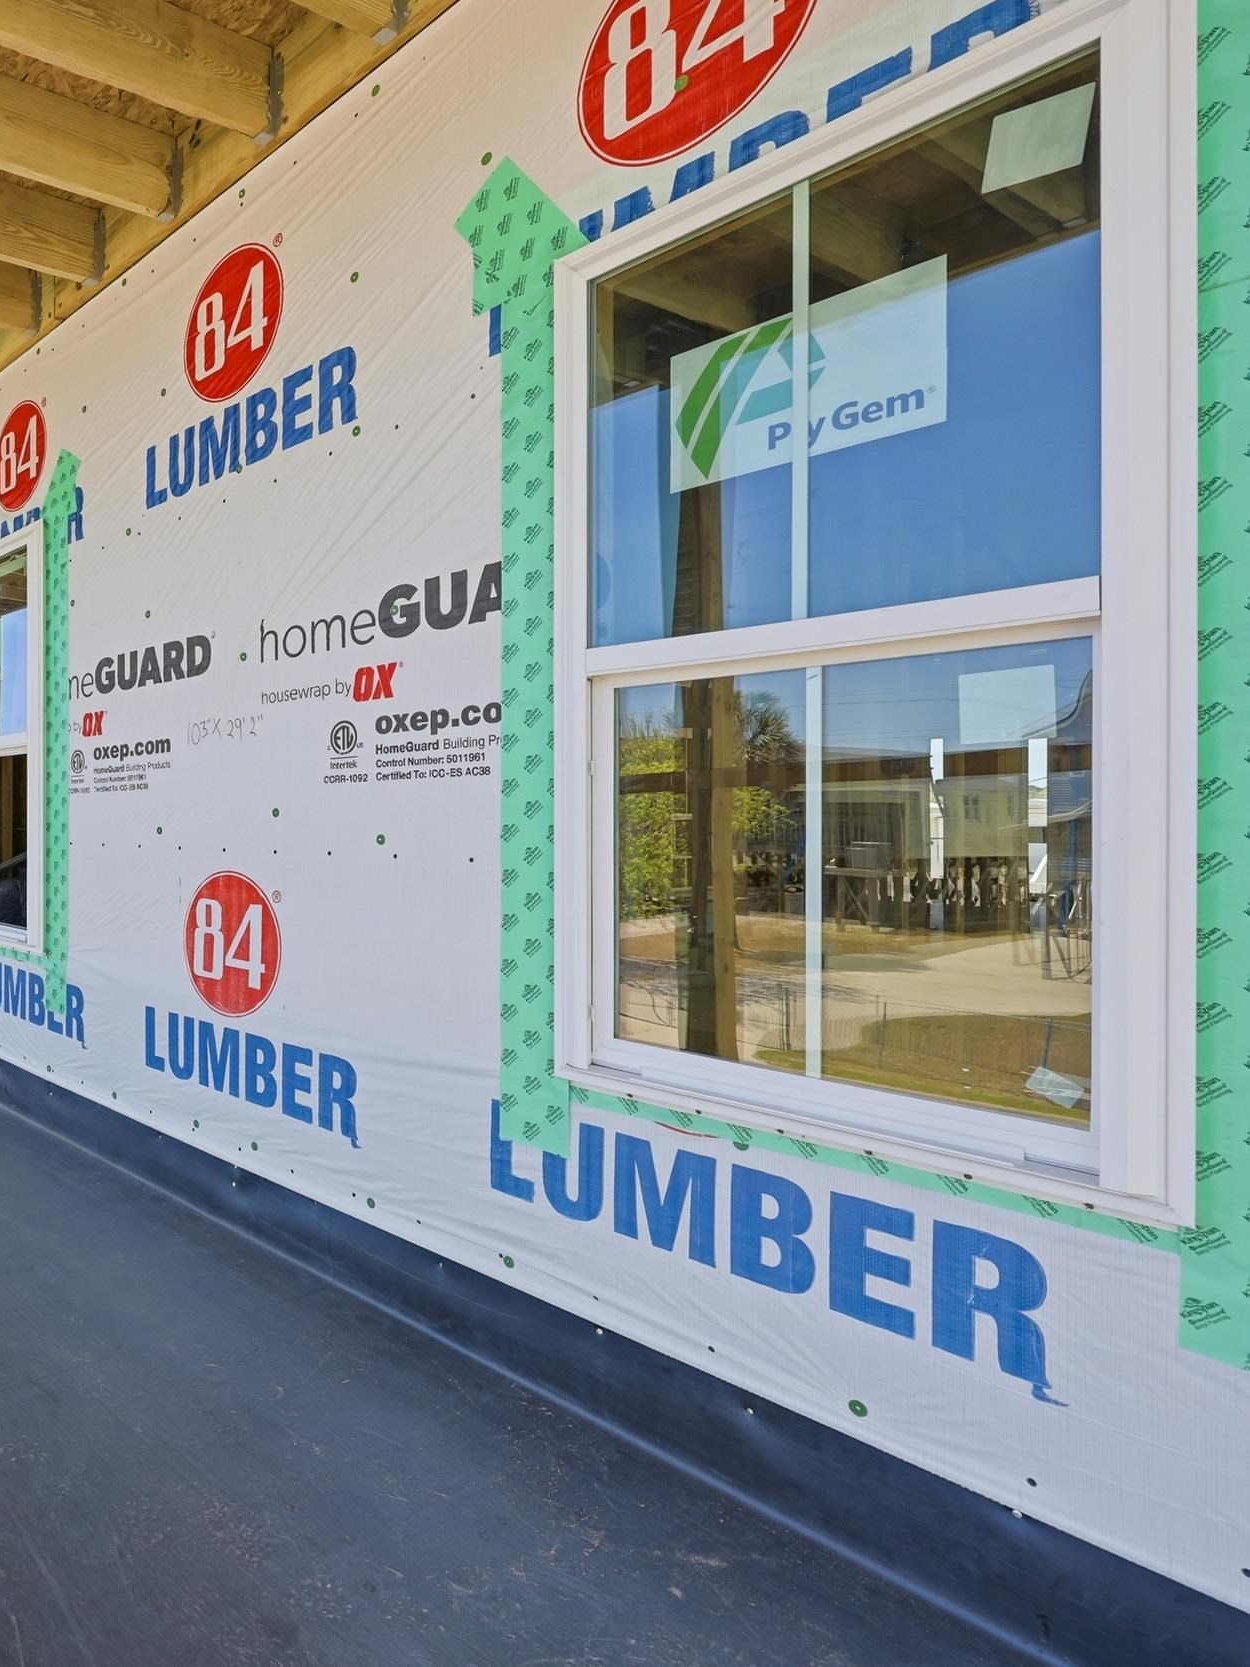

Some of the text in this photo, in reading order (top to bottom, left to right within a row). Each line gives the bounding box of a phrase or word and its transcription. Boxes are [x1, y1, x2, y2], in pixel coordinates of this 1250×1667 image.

[194, 260, 268, 382] 84
[145, 345, 359, 510] LUMBER
[768, 388, 925, 451] Py Gem
[0, 414, 39, 495] 84
[260, 561, 502, 664] homeGUA
[261, 662, 397, 704] housewrap by OX
[82, 710, 104, 737] OX
[375, 702, 502, 735] oxep.co
[93, 738, 172, 761] oxep.com
[330, 760, 358, 769] Intertek
[375, 740, 439, 755] HomeGuard
[443, 738, 485, 750] Building
[376, 752, 485, 769] Control Number: 5011961
[323, 774, 368, 784] CCRR-1092
[376, 766, 491, 782] Certified To: ICC-ES AC38
[193, 897, 266, 990] 84
[145, 1005, 362, 1149] LUMBER
[490, 1098, 1068, 1406] LUMBER
